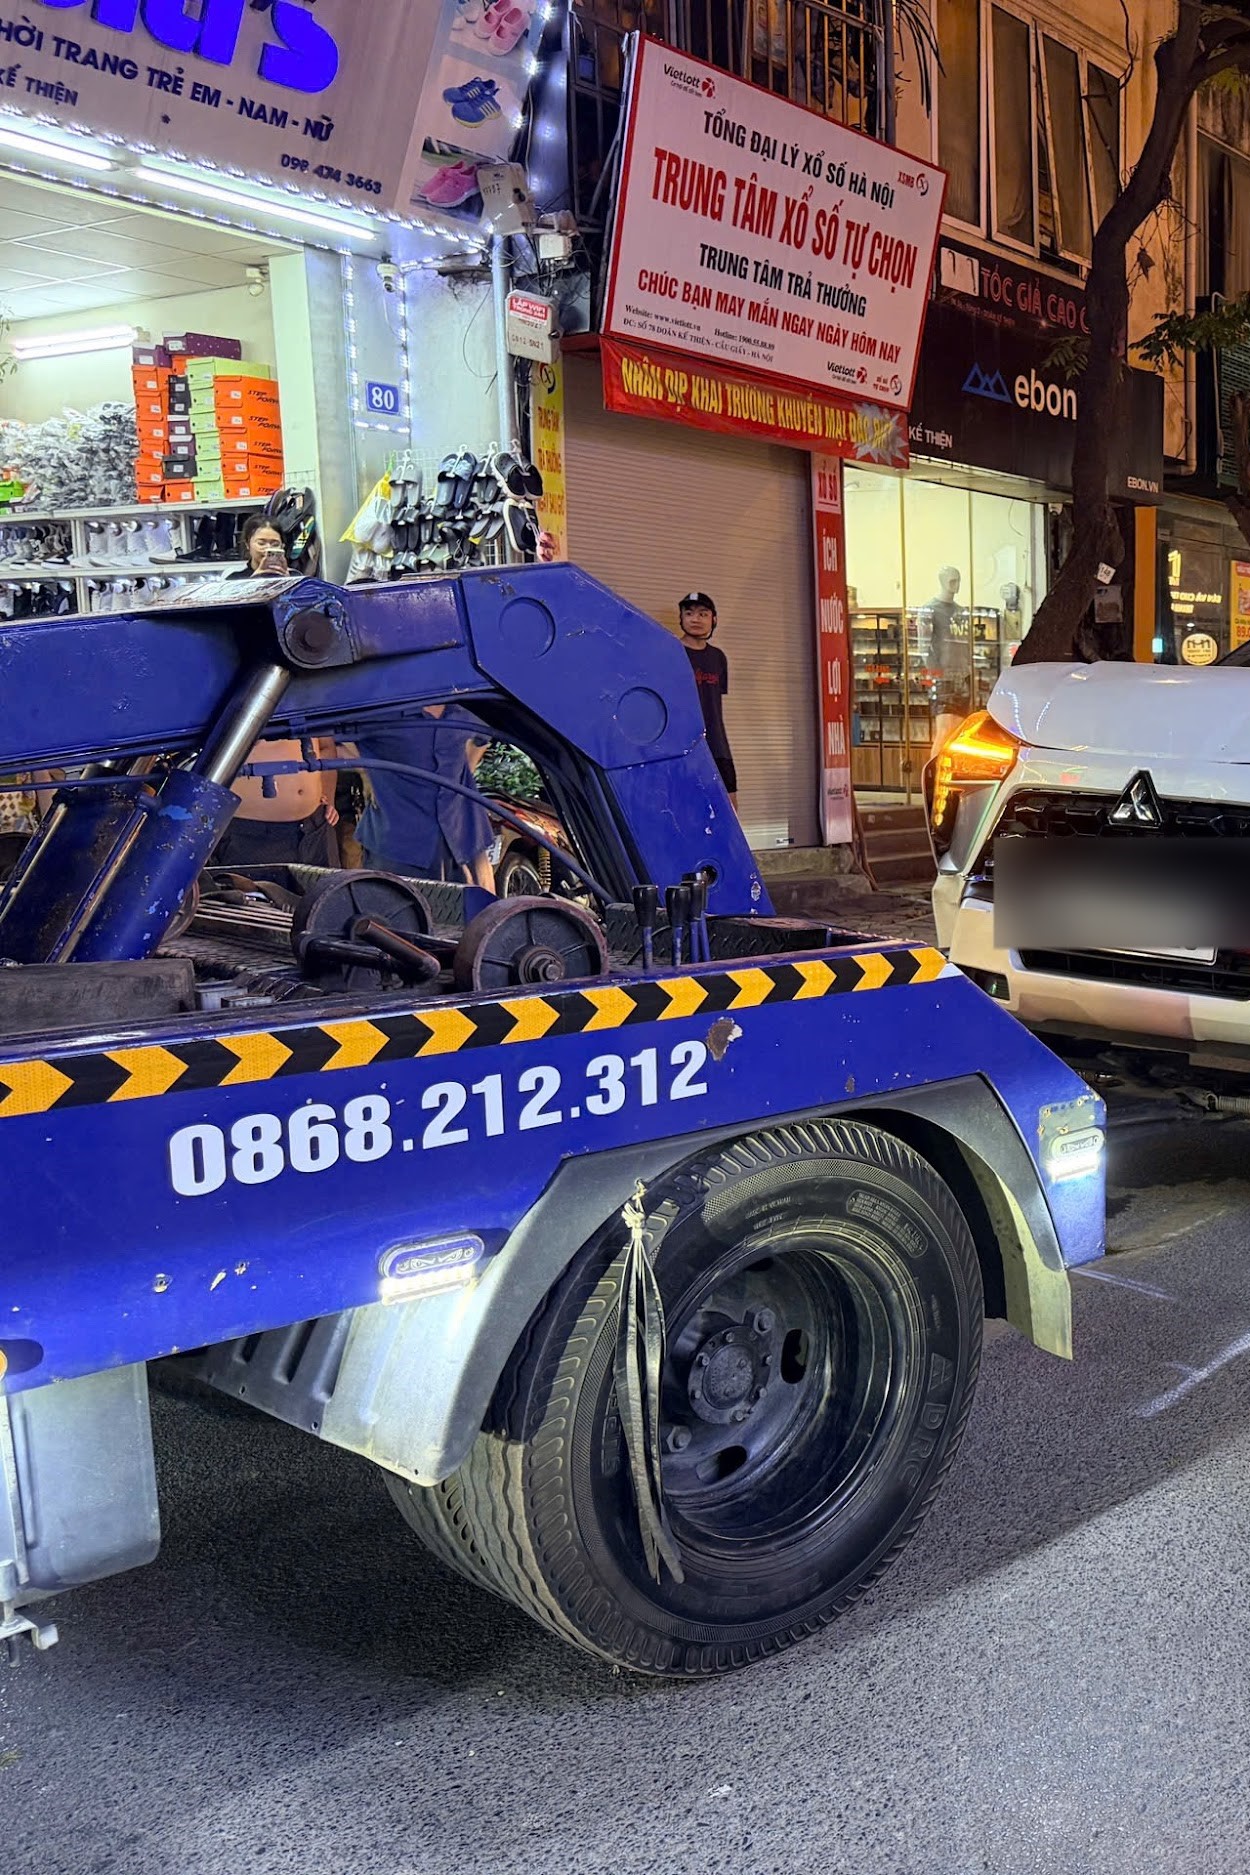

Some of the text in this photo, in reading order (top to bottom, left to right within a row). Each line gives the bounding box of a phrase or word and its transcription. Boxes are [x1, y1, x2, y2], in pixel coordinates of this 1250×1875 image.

[25, 76, 79, 107] THIỆN
[52, 36, 138, 80] TRANG
[147, 66, 184, 96] TRẺ
[190, 82, 221, 108] EM
[238, 97, 288, 128] NAM
[303, 114, 334, 141] NỮ
[664, 64, 700, 88] Vietlott
[281, 154, 309, 173] 098
[346, 173, 382, 195] 3663
[704, 109, 894, 209] TỔNG ĐẠI LÝ XỔ SỐ HÀ NỘI
[652, 147, 918, 294] TRUNG TÂM XỔ SỐ TỰ CHỌN
[700, 243, 866, 318] TRUNG TÂM TRẢ THƯỞNG
[981, 263, 1013, 307] TÓC
[1017, 278, 1042, 318] GIẢ
[1047, 293, 1077, 329] CAO
[638, 269, 901, 364] CHÚC BẠN MAY MẮN NGAY NGÀY HÔM NAY
[827, 361, 856, 377] Vietlott
[372, 386, 395, 410] 80
[621, 356, 662, 400] NHÂN
[665, 369, 688, 412] DỊP
[691, 374, 723, 412] KHAI
[825, 403, 848, 447] MẠI
[1015, 368, 1077, 420] ebon
[909, 422, 952, 449] KẾ THIỆN
[823, 528, 838, 572] ÍCH
[821, 592, 844, 634] NƯỚC
[827, 657, 842, 703] LỢI
[827, 714, 846, 755] NHÀ
[168, 1040, 708, 1197] 0868.212.312
